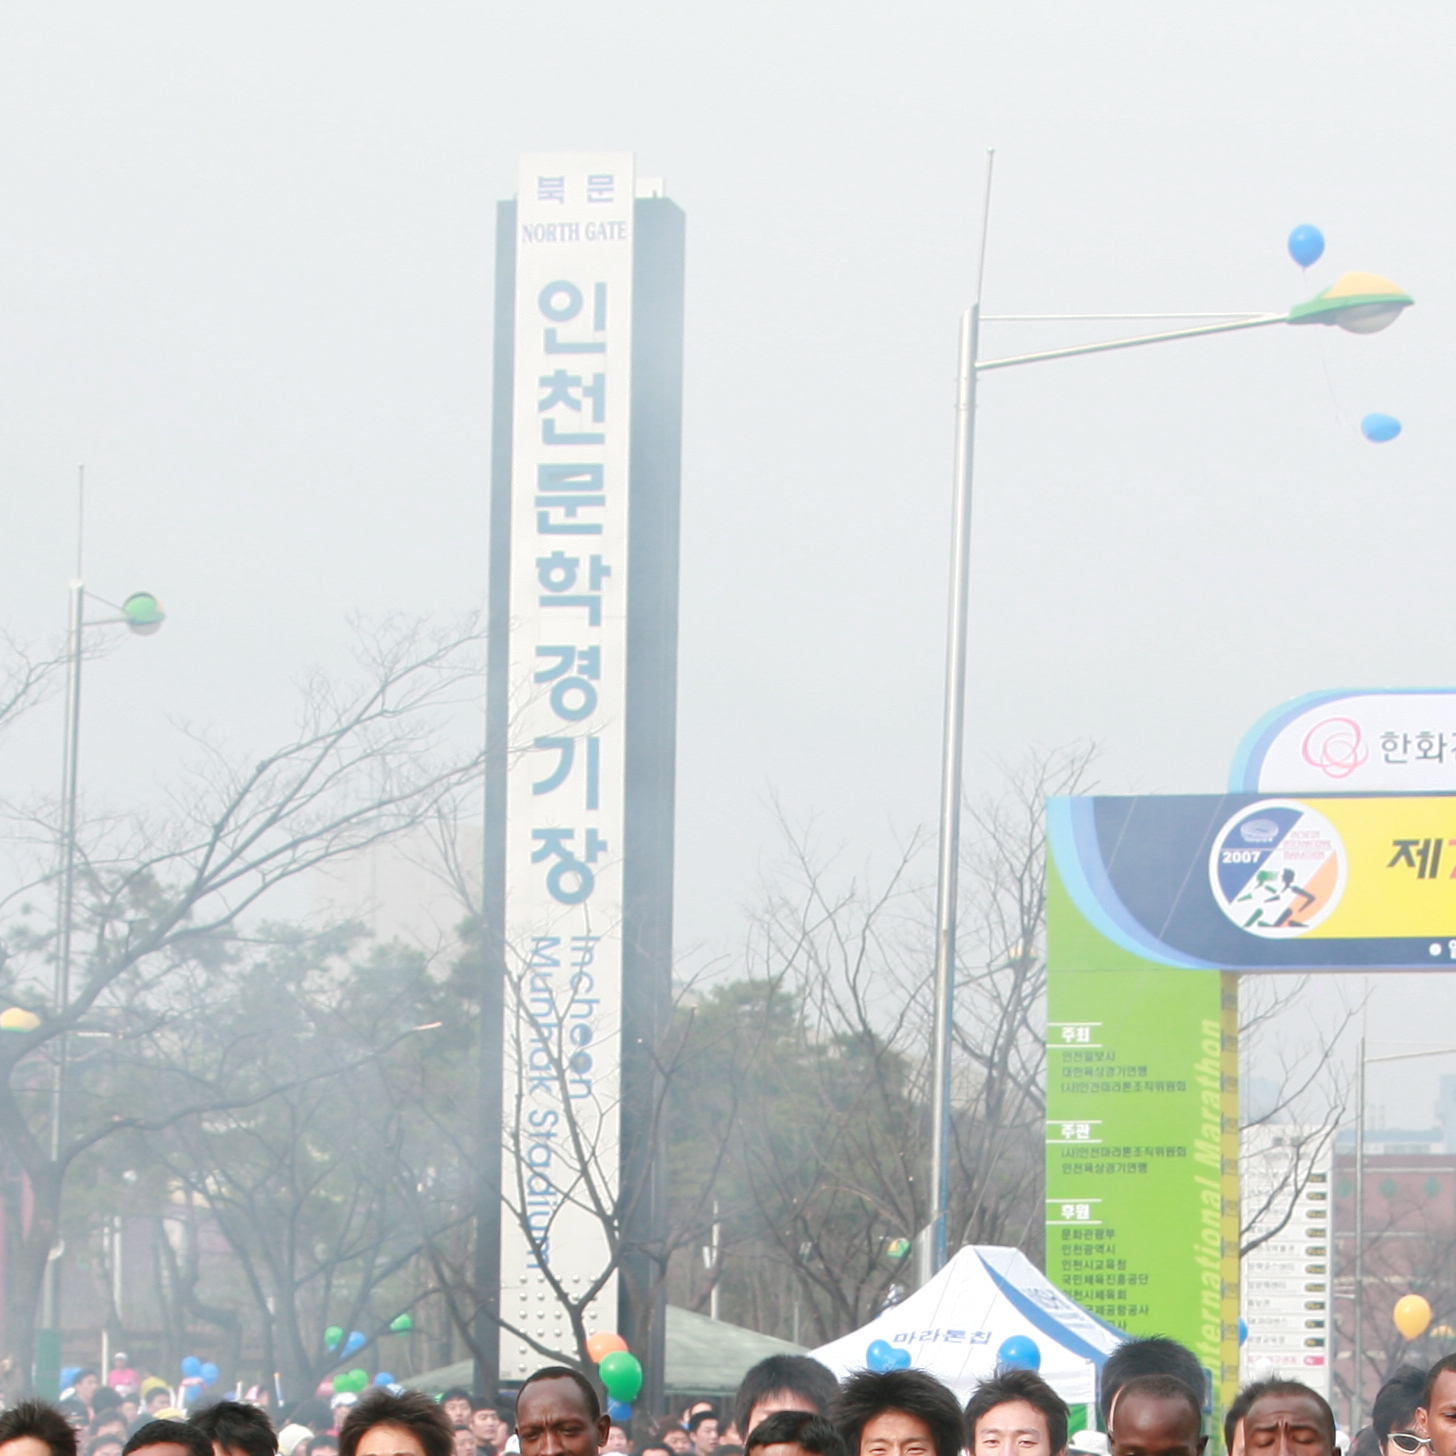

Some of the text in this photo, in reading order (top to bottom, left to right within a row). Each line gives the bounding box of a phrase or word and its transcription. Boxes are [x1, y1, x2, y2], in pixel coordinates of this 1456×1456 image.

[521, 220, 627, 244] NORTH GATE
[1222, 851, 1262, 864] 2007
[569, 935, 601, 1101] Incheon
[1061, 1026, 1091, 1043] 주최
[525, 1108, 559, 1270] Stadium
[892, 1328, 993, 1346] 마라톤칩
